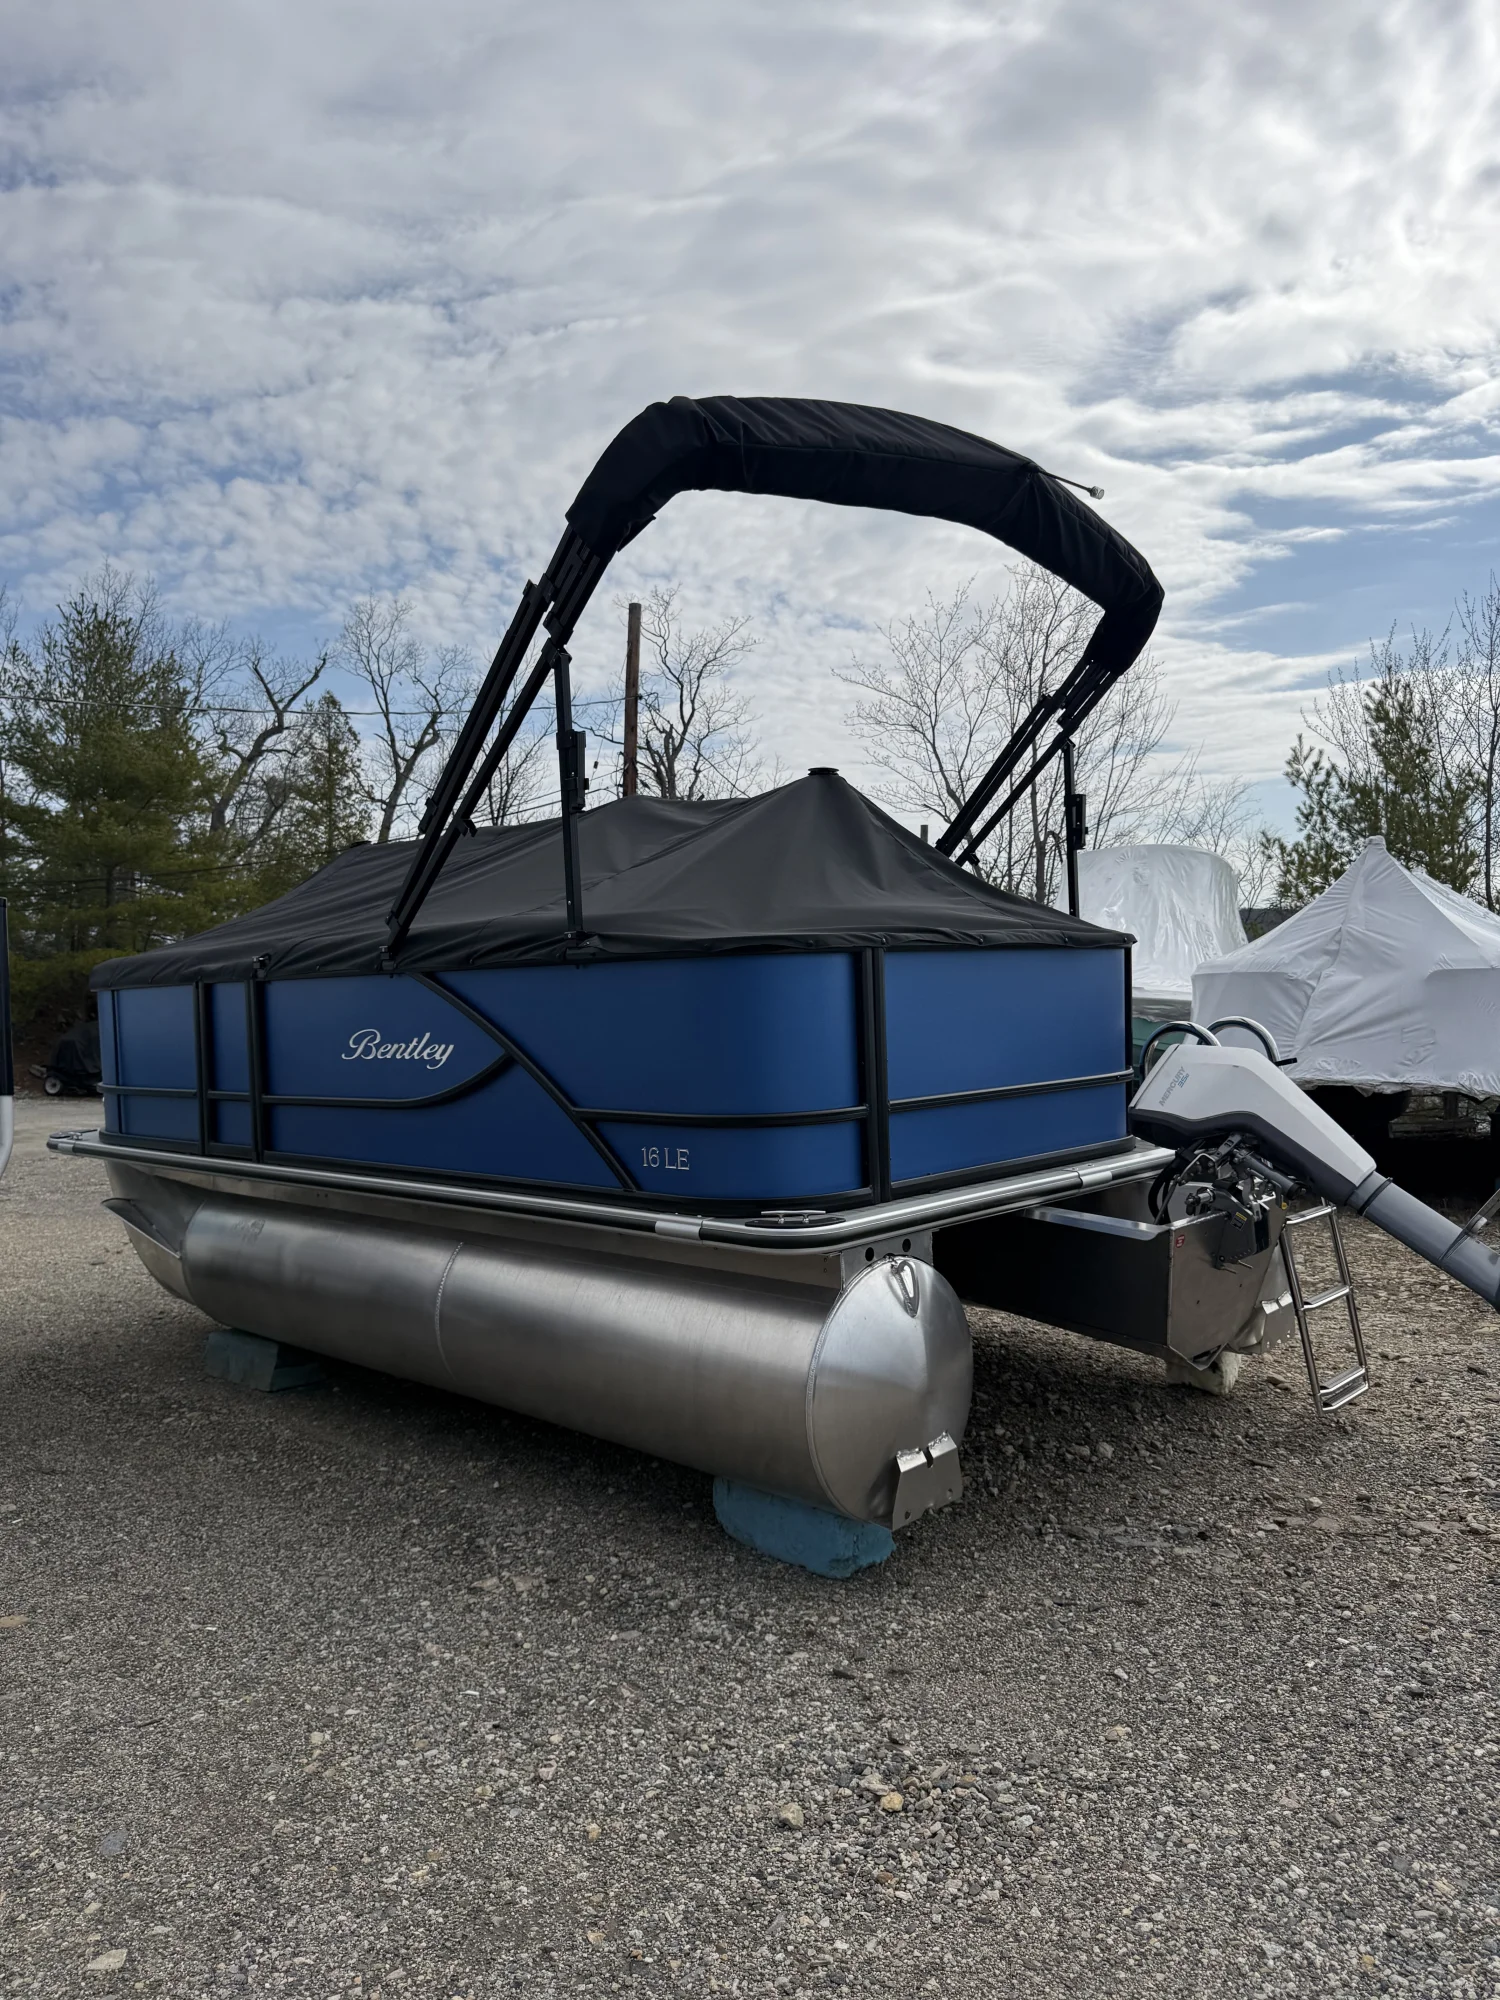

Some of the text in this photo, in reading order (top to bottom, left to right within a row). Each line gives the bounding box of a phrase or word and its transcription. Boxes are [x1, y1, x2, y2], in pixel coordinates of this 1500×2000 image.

[341, 1028, 455, 1070] Bentley
[1159, 1066, 1185, 1107] MERCURY
[641, 1146, 690, 1171] 16 LE
